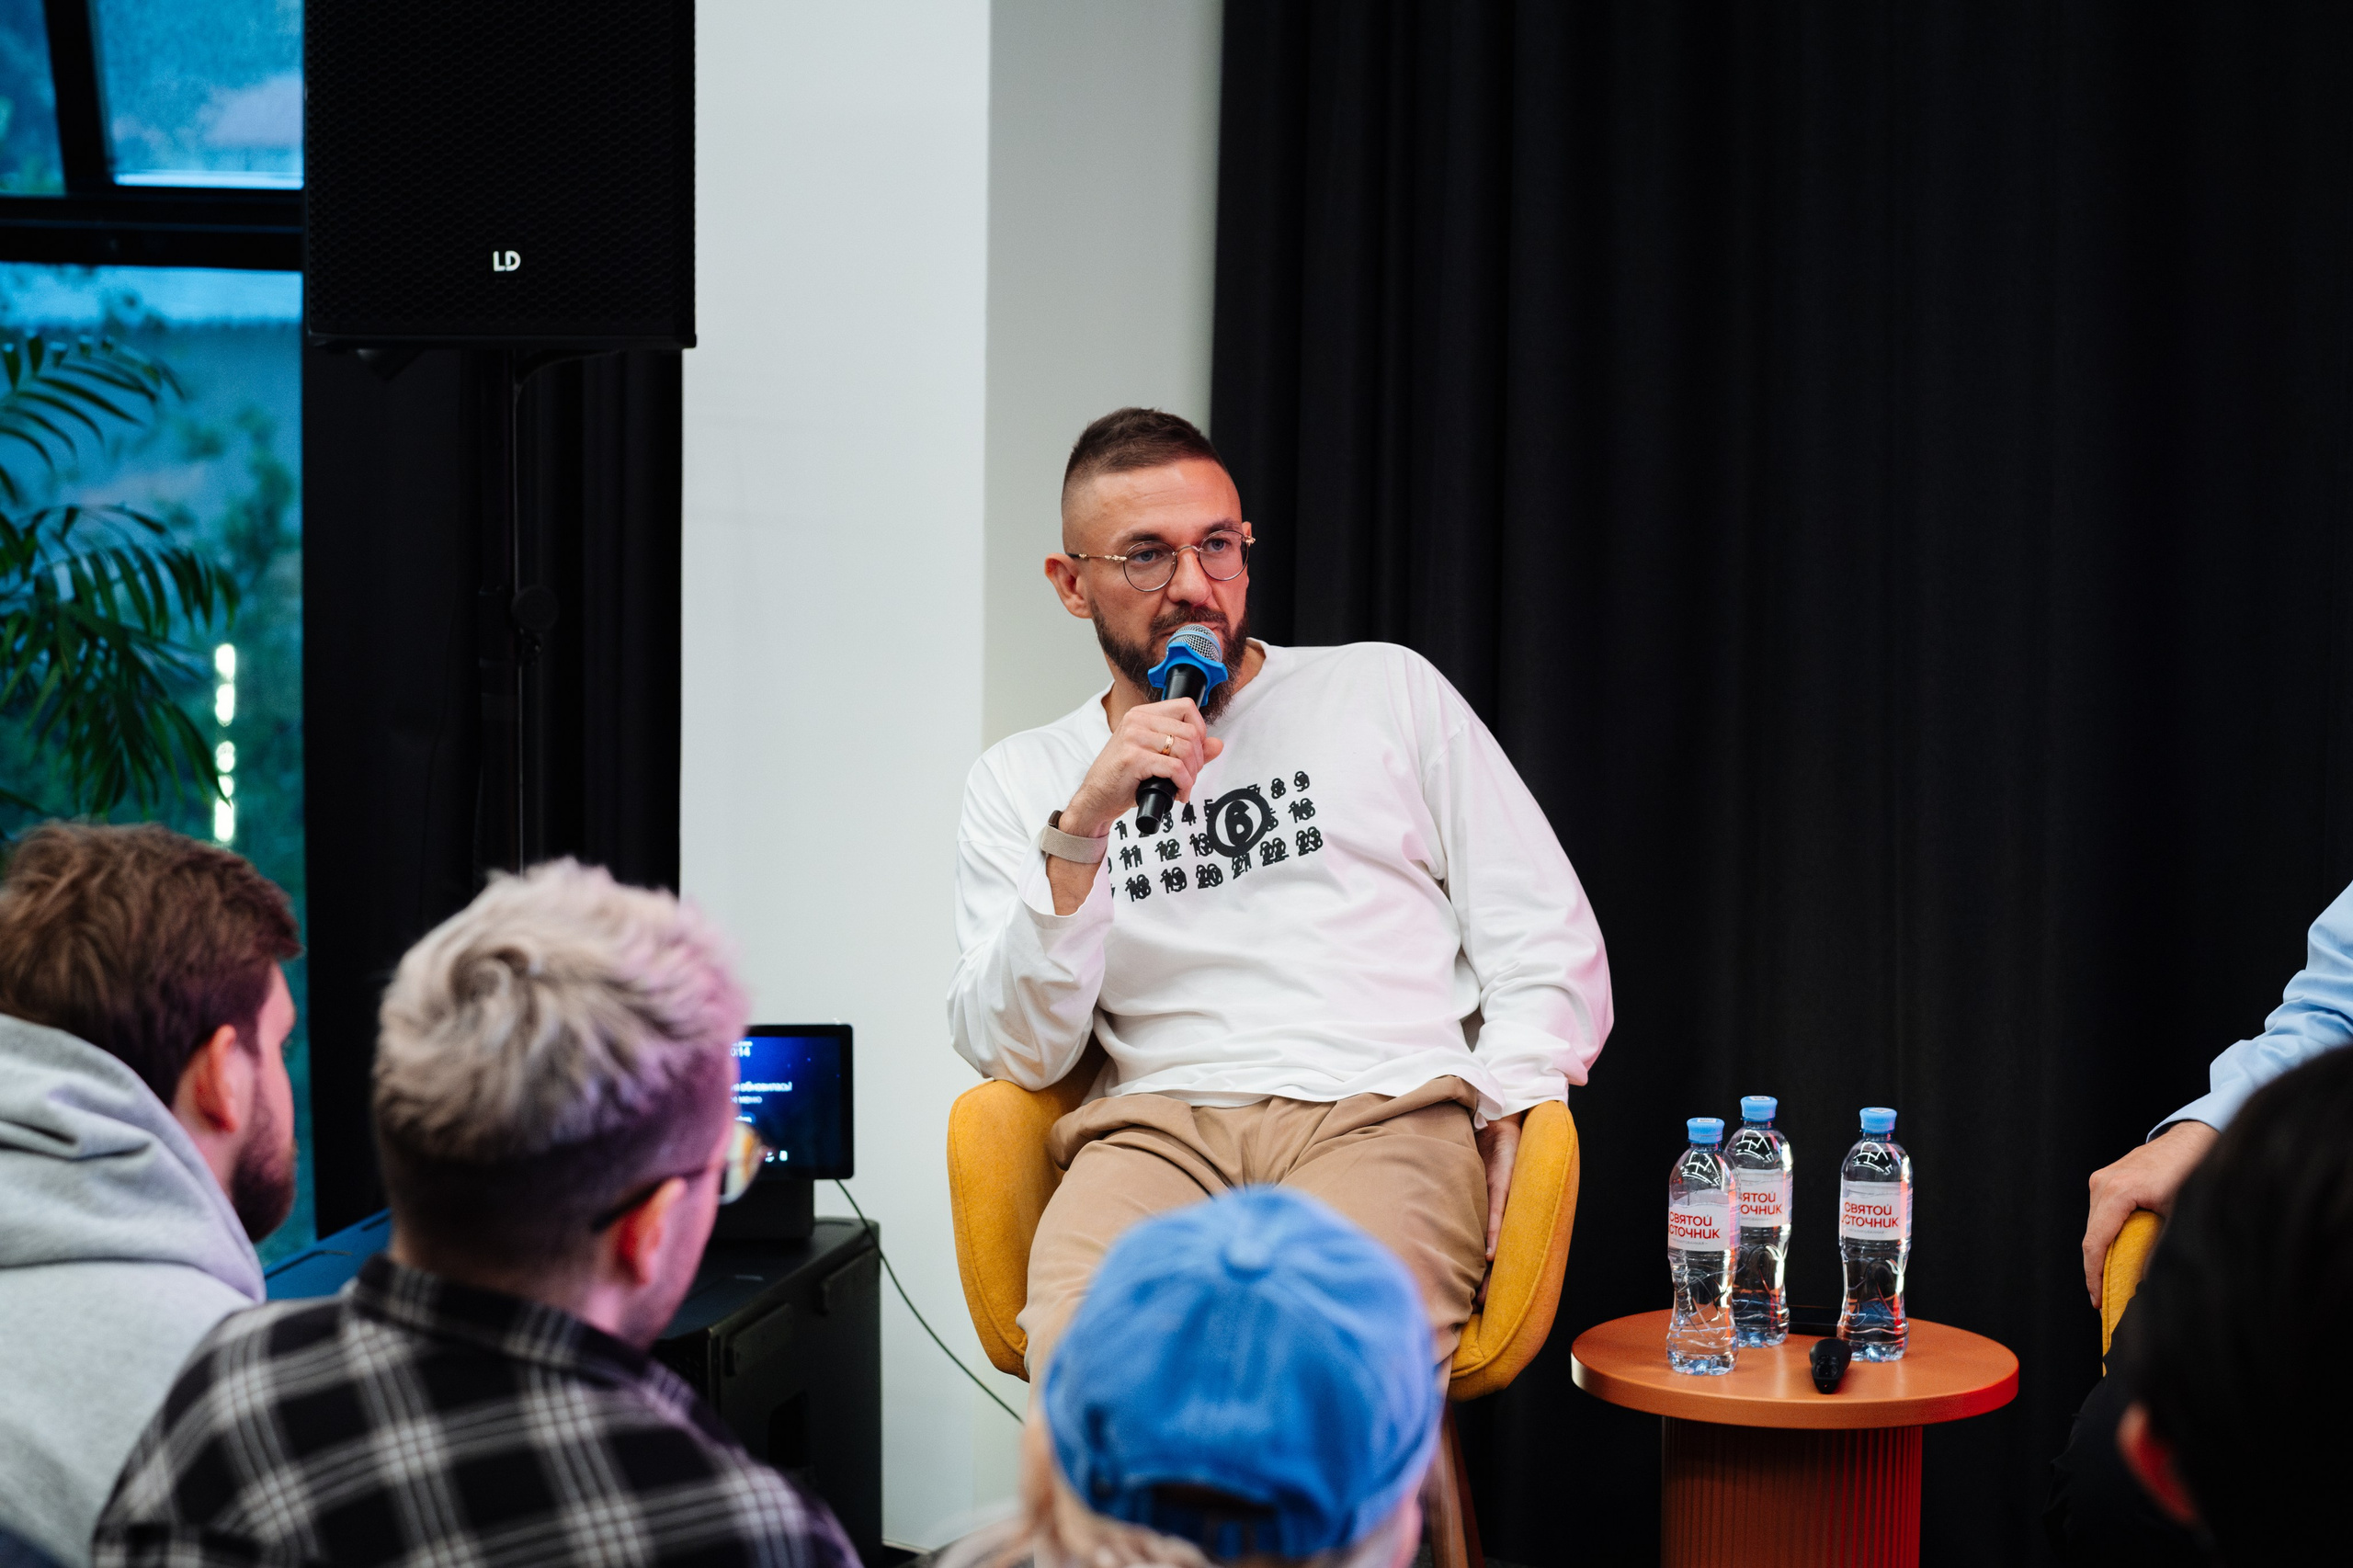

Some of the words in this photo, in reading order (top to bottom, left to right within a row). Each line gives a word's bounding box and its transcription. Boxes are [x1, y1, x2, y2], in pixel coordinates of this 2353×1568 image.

[493, 250, 521, 272] LD
[1181, 801, 1197, 826] 4
[1224, 800, 1254, 846] 6
[1270, 778, 1286, 800] 8
[1293, 770, 1310, 792] 9
[1119, 845, 1142, 870] 11
[1154, 838, 1182, 862] 12
[1288, 798, 1315, 824] 16
[1160, 867, 1188, 894] 19
[1196, 863, 1223, 890] 20
[1296, 826, 1324, 857] 23
[1739, 1190, 1777, 1203] ЯТОЙ
[1739, 1203, 1783, 1215] ОЧНИК
[1668, 1223, 1721, 1240] СТОЧНИК
